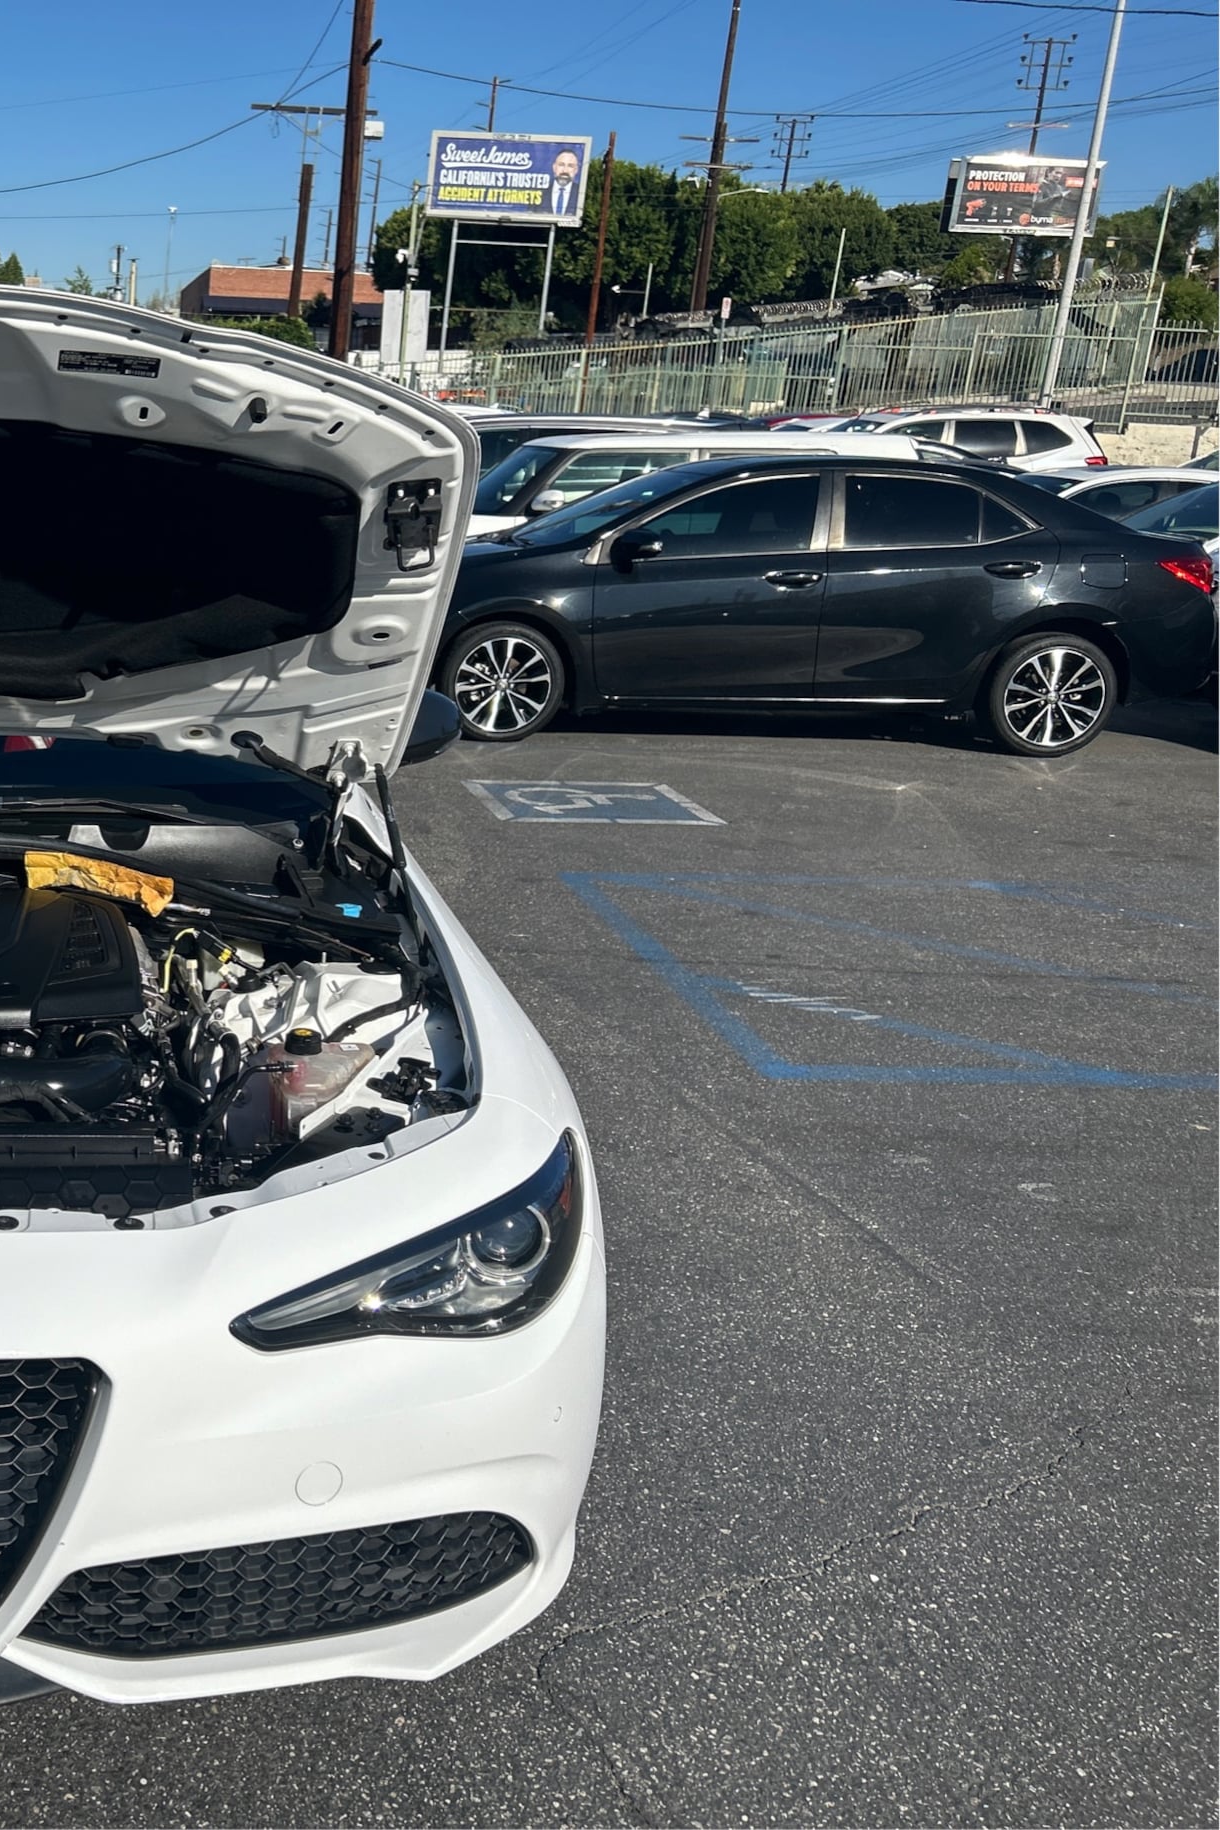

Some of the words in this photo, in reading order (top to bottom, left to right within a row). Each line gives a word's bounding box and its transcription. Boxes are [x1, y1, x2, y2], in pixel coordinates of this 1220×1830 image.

[441, 143, 485, 163] Sweet
[440, 169, 505, 186] CALIFORNIA'S
[506, 172, 550, 189] TRUSTED
[969, 170, 1026, 182] PROTECTION
[438, 186, 486, 202] ACCIDENT
[486, 188, 542, 205] ATTORNEYS
[967, 181, 981, 191] ON
[982, 182, 1008, 192] YOUR
